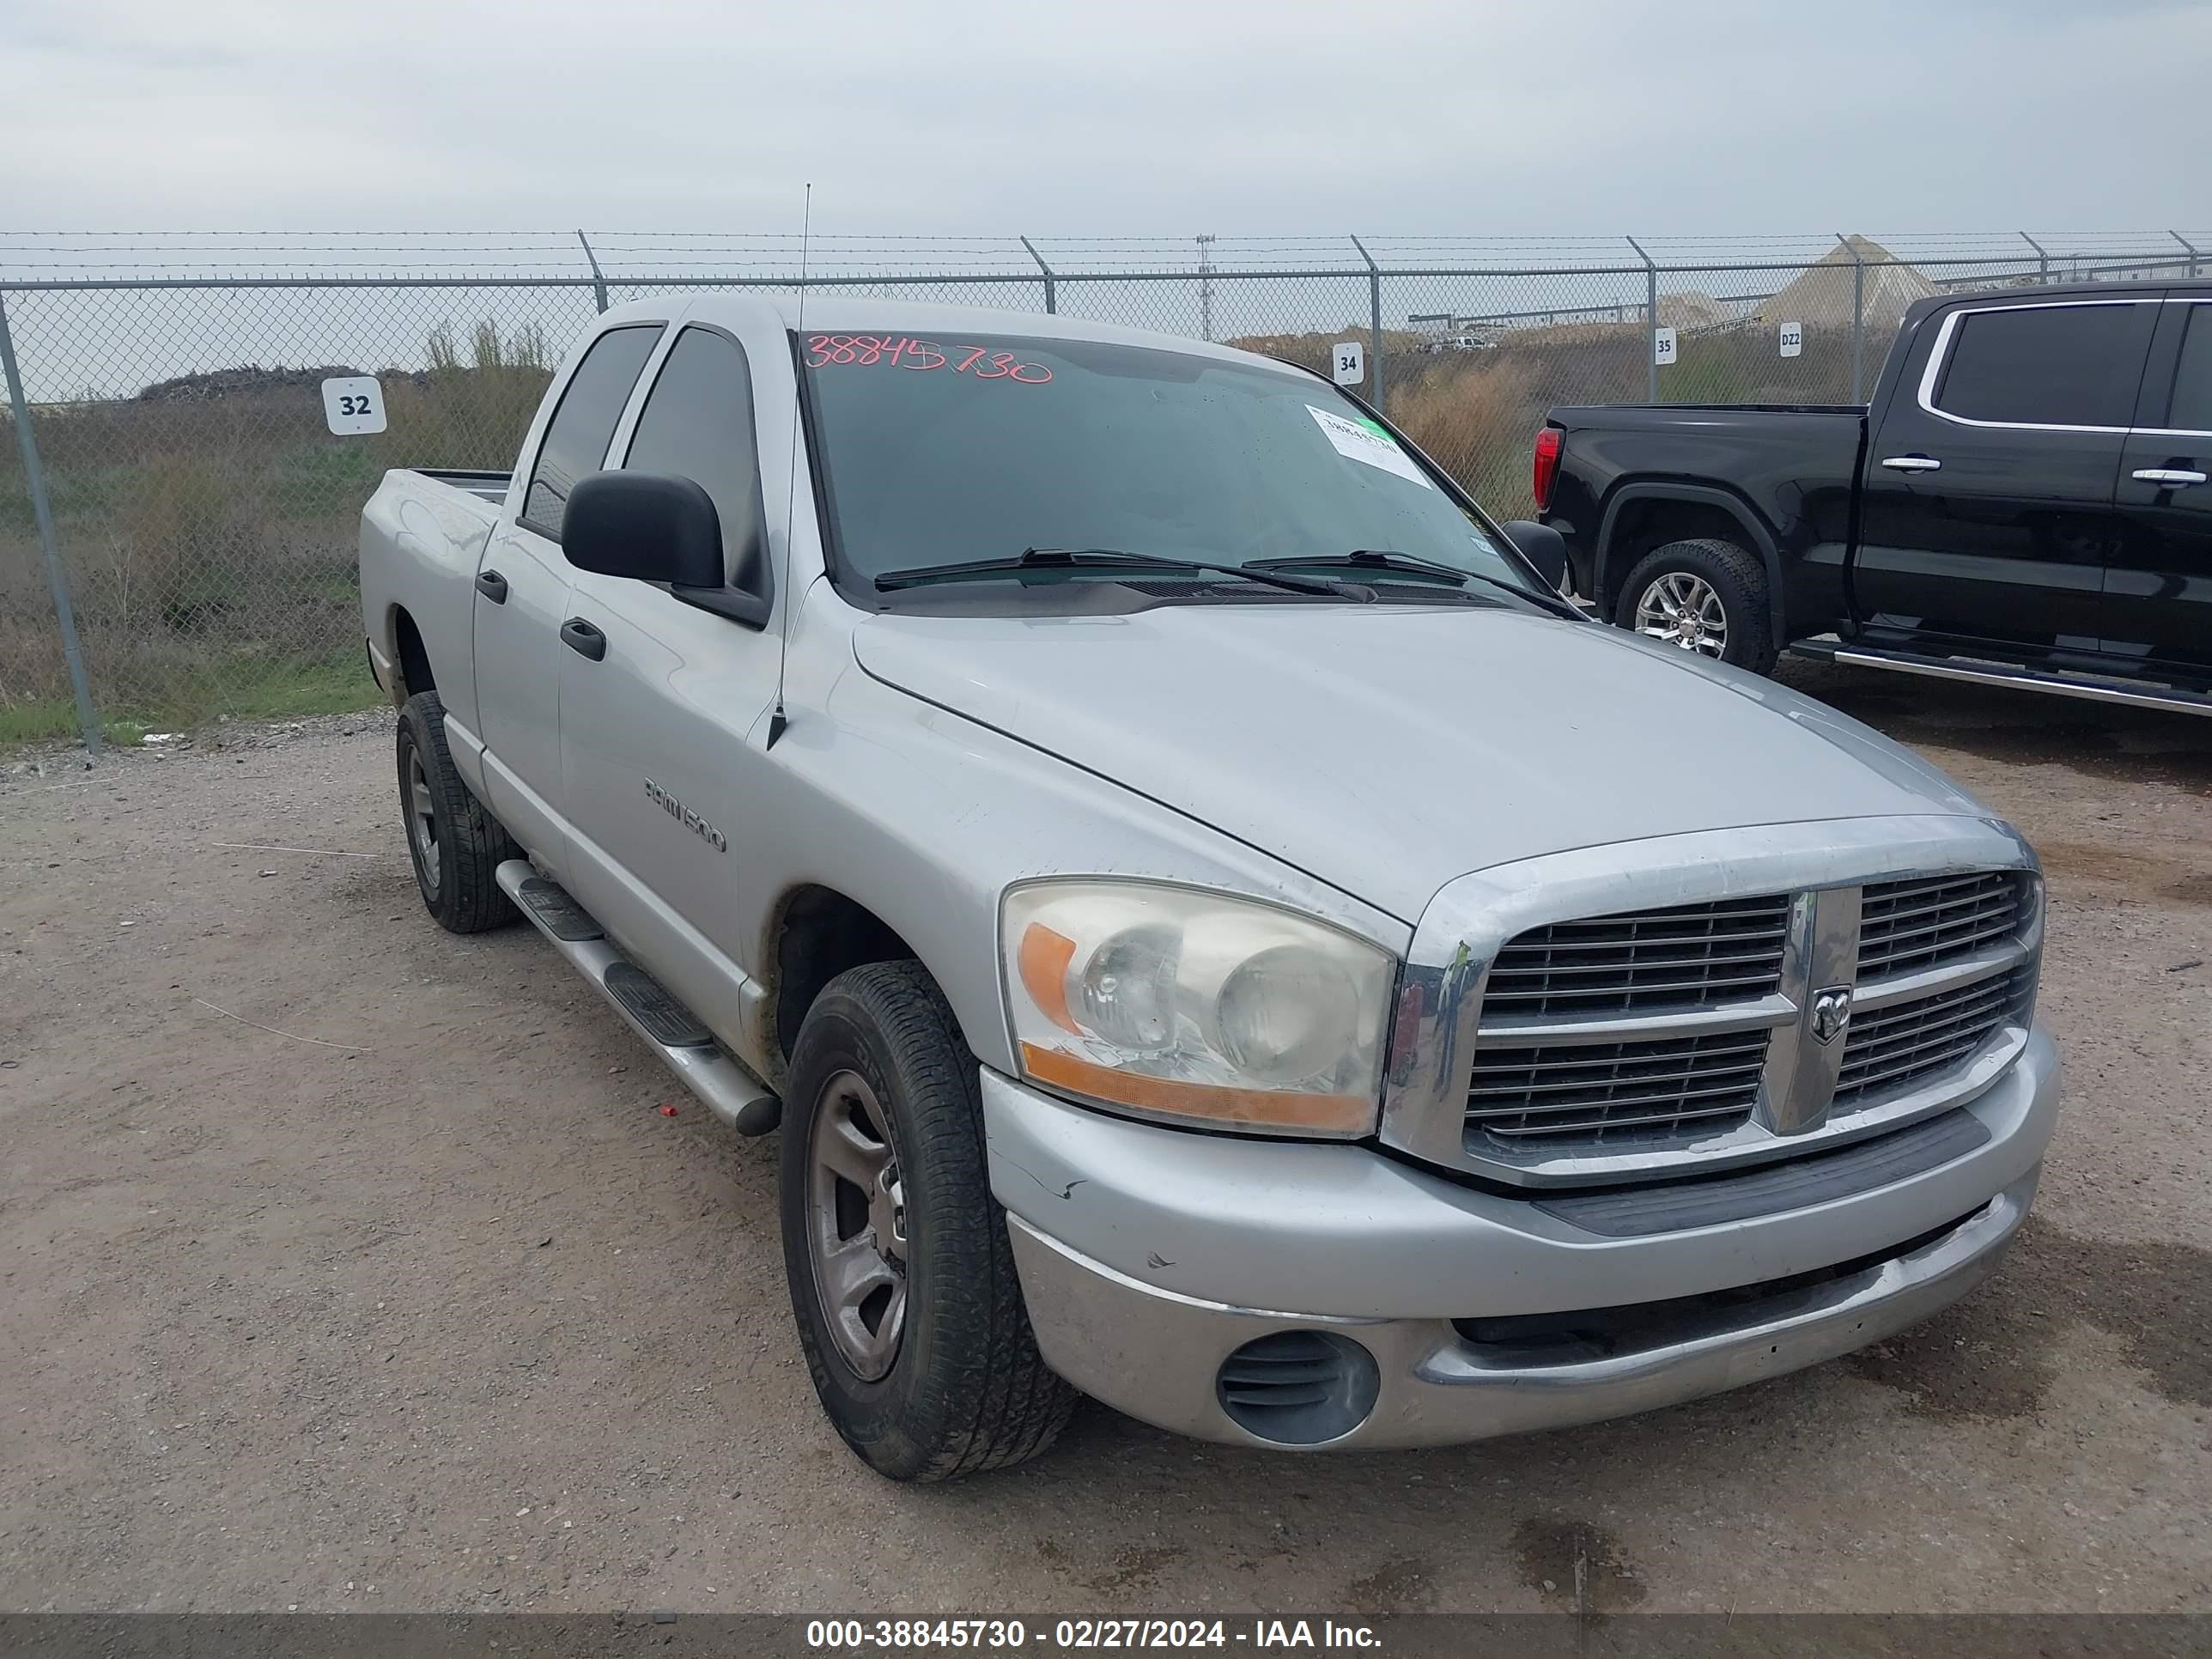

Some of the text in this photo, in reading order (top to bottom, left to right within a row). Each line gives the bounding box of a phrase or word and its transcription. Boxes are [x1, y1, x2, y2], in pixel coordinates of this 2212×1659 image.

[1658, 340, 1671, 353] 35
[1782, 333, 1800, 346] DZ2
[1340, 356, 1357, 371] 34
[339, 395, 372, 416] 32
